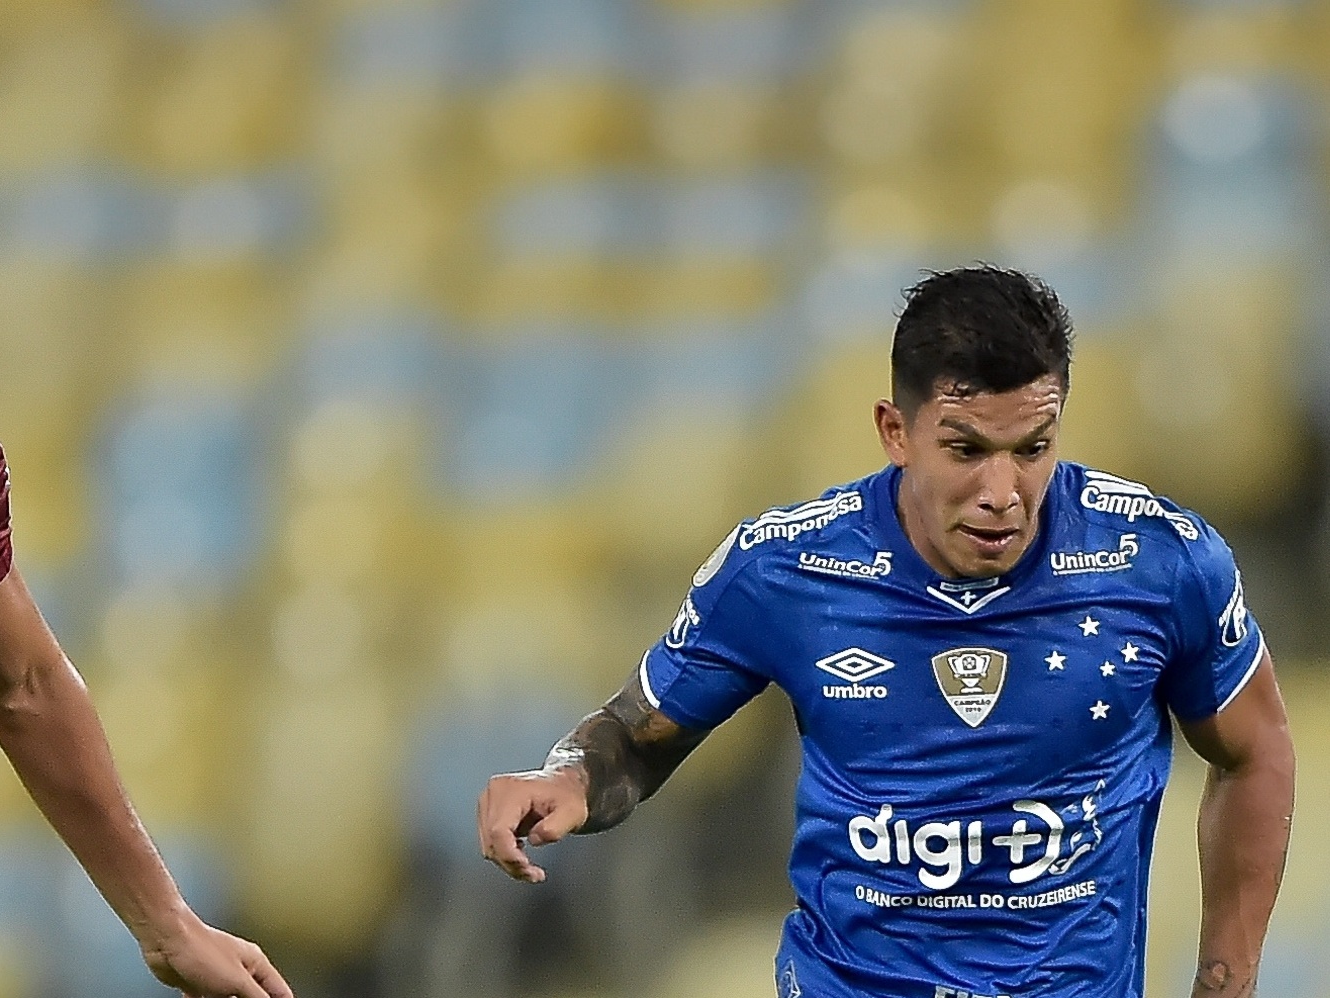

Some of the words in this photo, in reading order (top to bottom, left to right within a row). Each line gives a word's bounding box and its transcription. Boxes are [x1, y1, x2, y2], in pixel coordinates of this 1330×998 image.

[822, 683, 888, 699] umbro
[855, 885, 864, 900] O
[865, 887, 913, 908] BANCO
[917, 894, 975, 909] DIGITAL
[979, 894, 1005, 908] DO
[1007, 880, 1096, 910] CRUZEIRENSE
